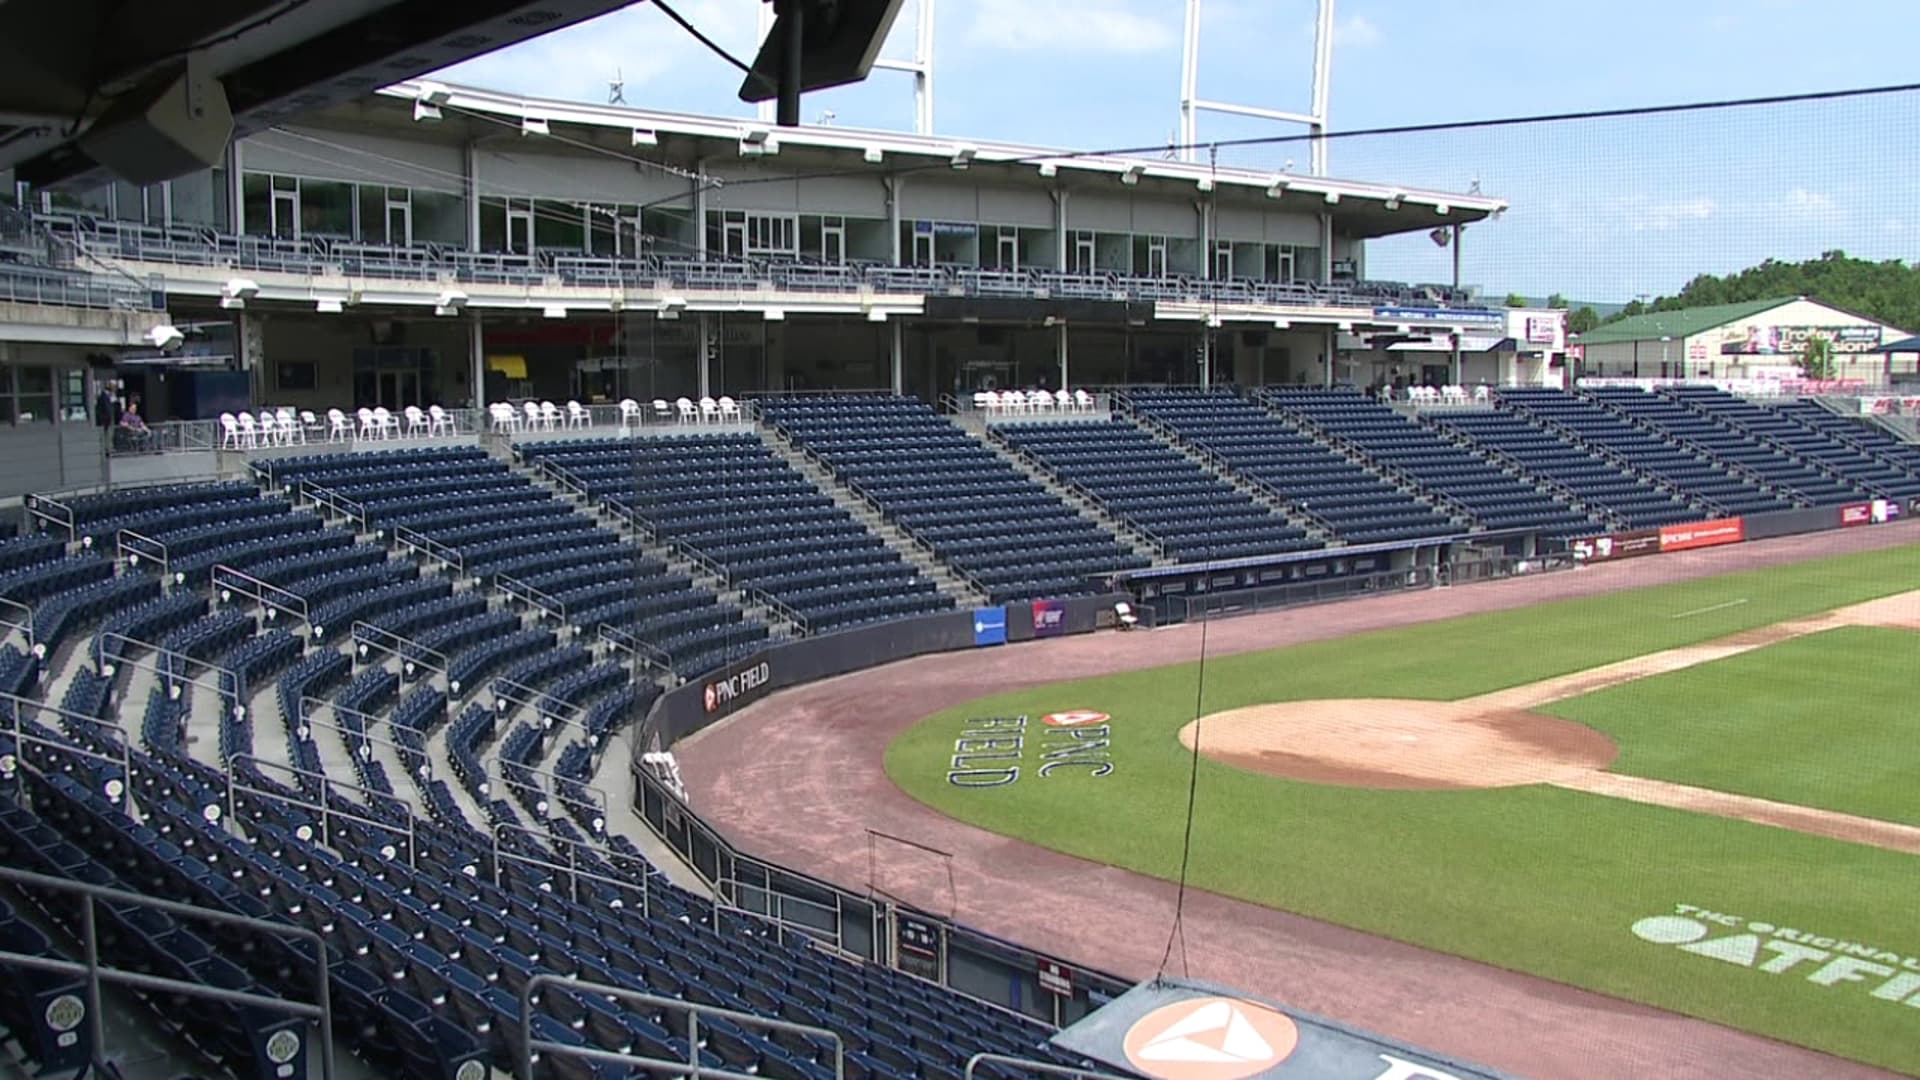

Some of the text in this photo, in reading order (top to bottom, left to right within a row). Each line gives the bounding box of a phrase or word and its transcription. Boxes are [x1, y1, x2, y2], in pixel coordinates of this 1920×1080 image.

[1779, 341, 1878, 353] Excsions
[715, 661, 769, 705] PNC FIELD
[946, 714, 1028, 788] FIELD
[1038, 724, 1114, 778] PNC
[1675, 903, 1744, 926] THE
